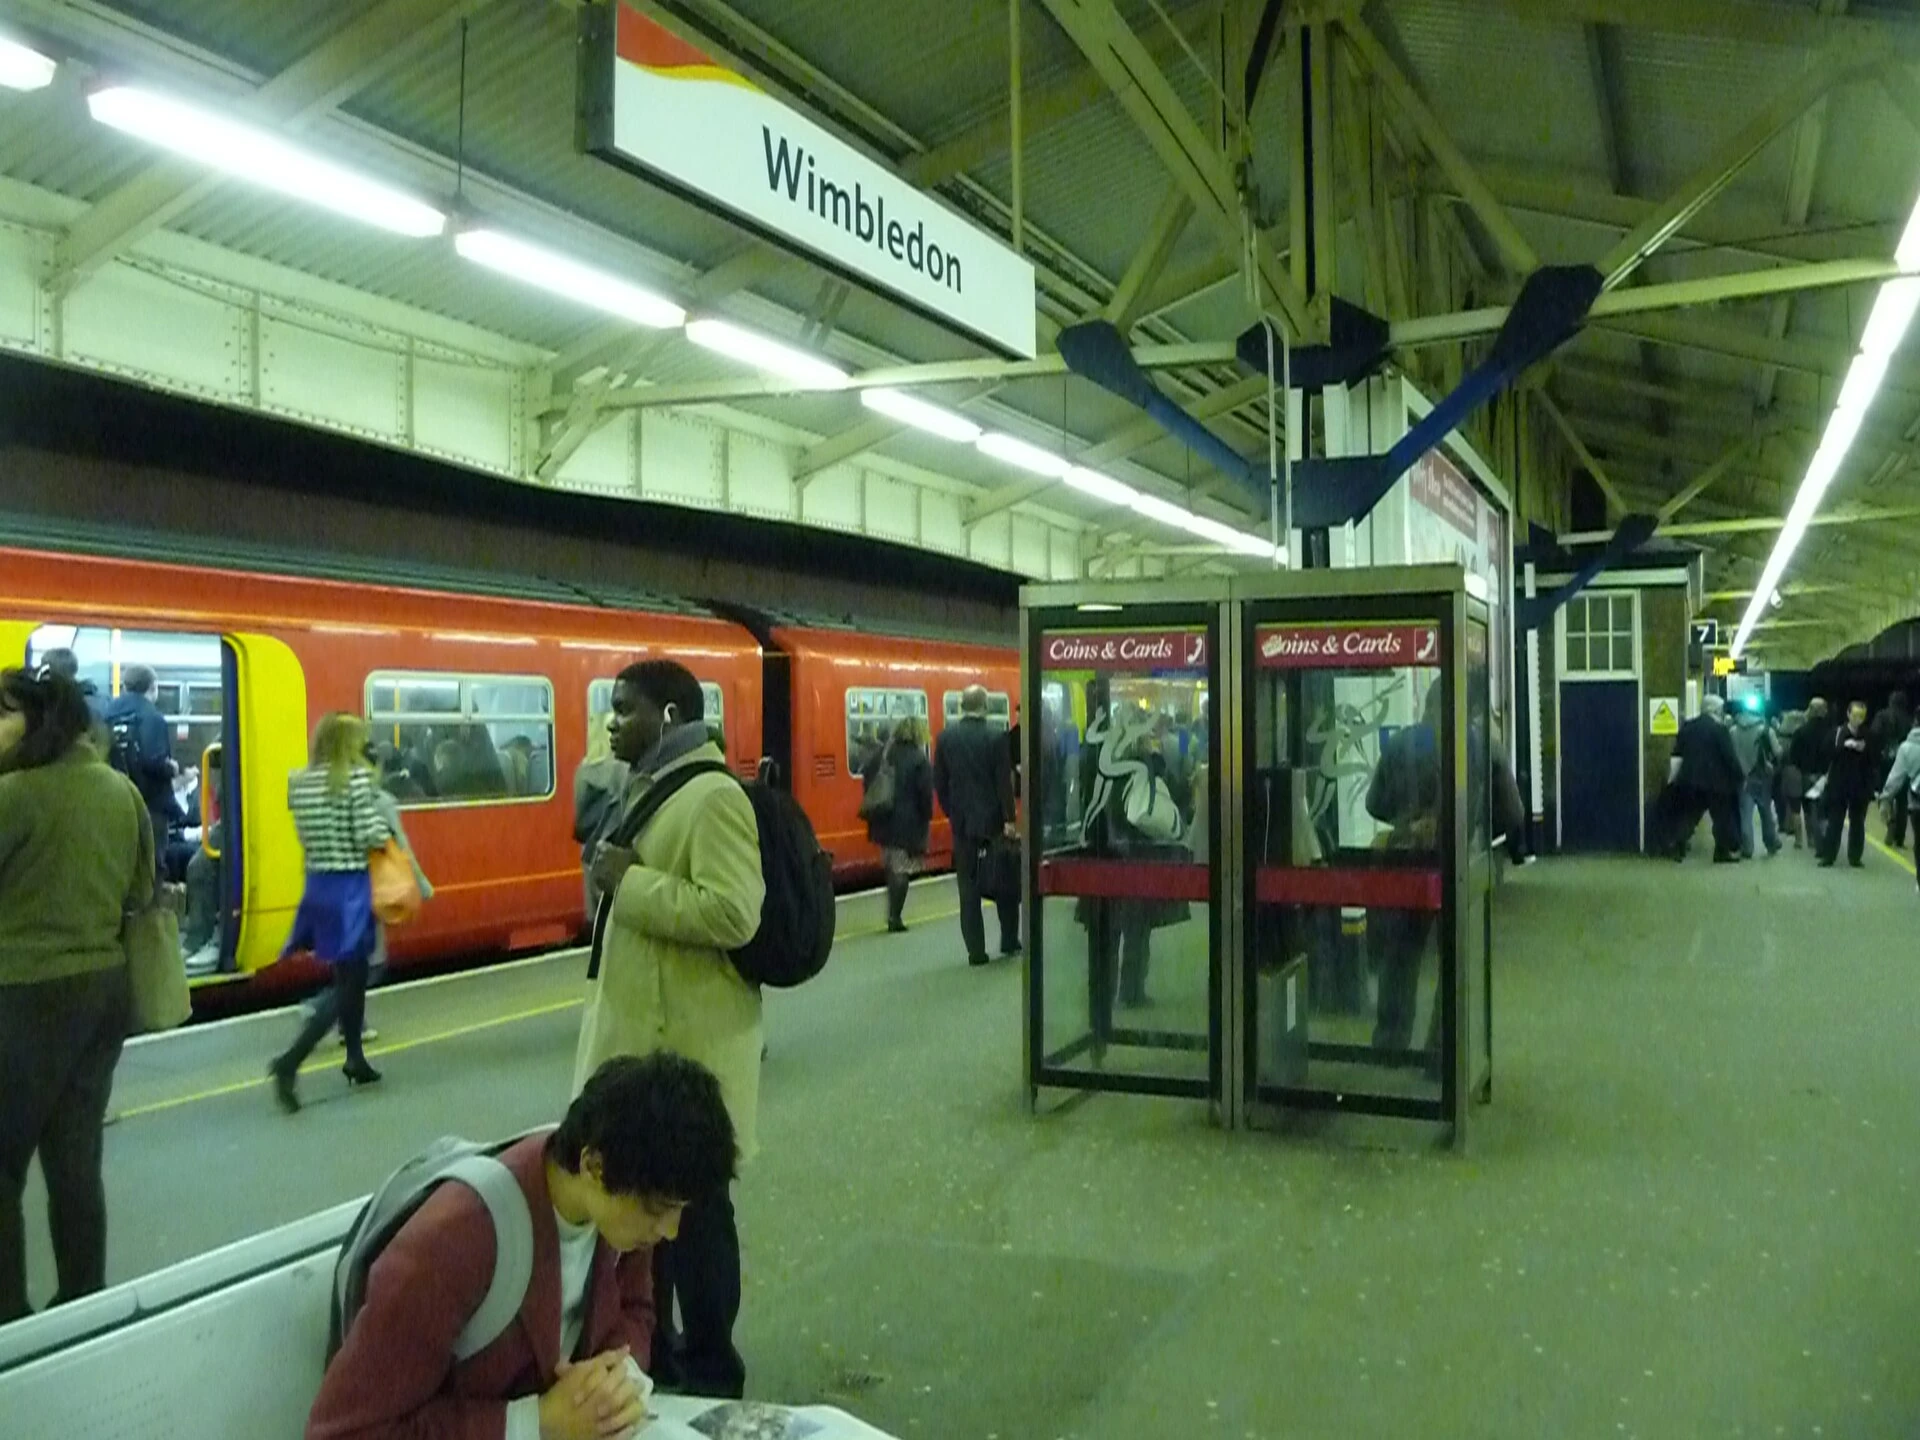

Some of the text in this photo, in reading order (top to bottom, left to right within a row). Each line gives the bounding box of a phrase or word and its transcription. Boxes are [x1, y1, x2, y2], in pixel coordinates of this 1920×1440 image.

[762, 123, 962, 294] Wimbledon
[1262, 632, 1402, 658] oins & Cards
[1697, 625, 1710, 642] 7
[1049, 637, 1173, 660] Coins & Cards
